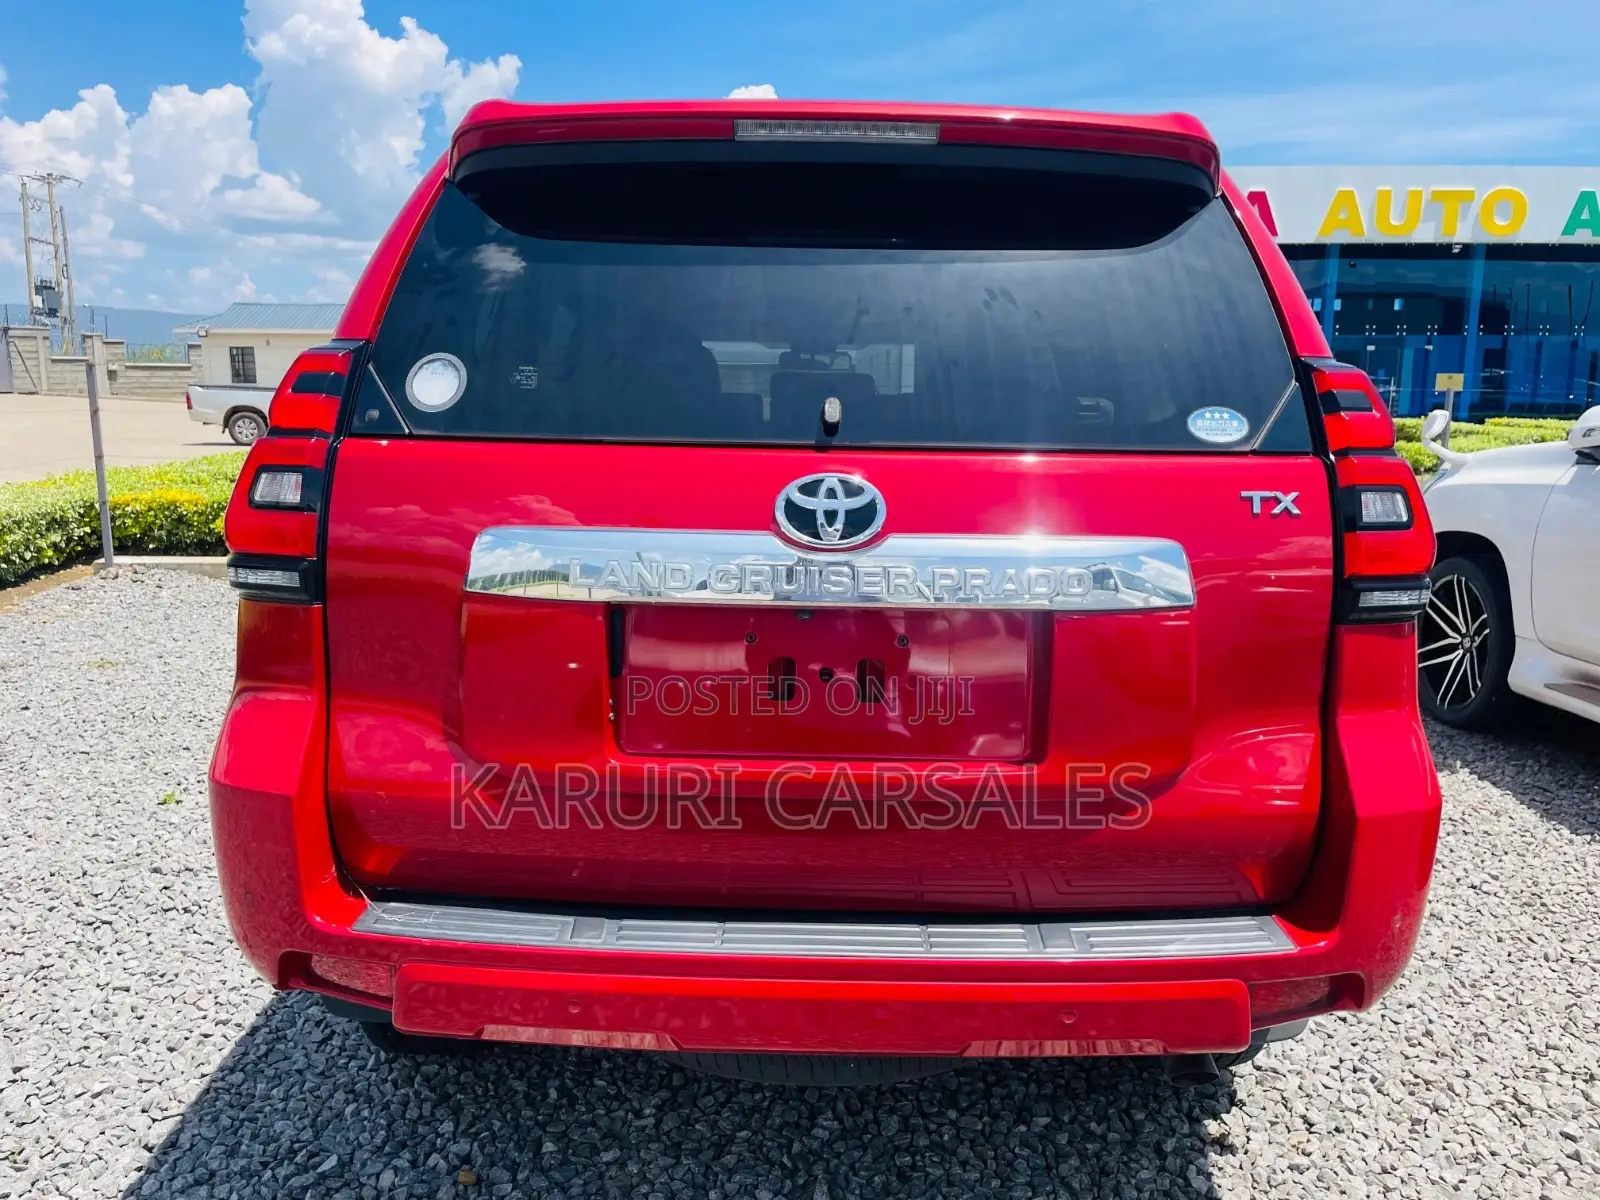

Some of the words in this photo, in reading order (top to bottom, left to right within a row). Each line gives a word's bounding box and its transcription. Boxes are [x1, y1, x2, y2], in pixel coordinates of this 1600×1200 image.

[1317, 188, 1529, 237] AUTO
[1240, 490, 1302, 517] TX
[568, 557, 695, 590] LAND
[708, 562, 919, 597] CRUISER
[932, 566, 1094, 597] PRADO
